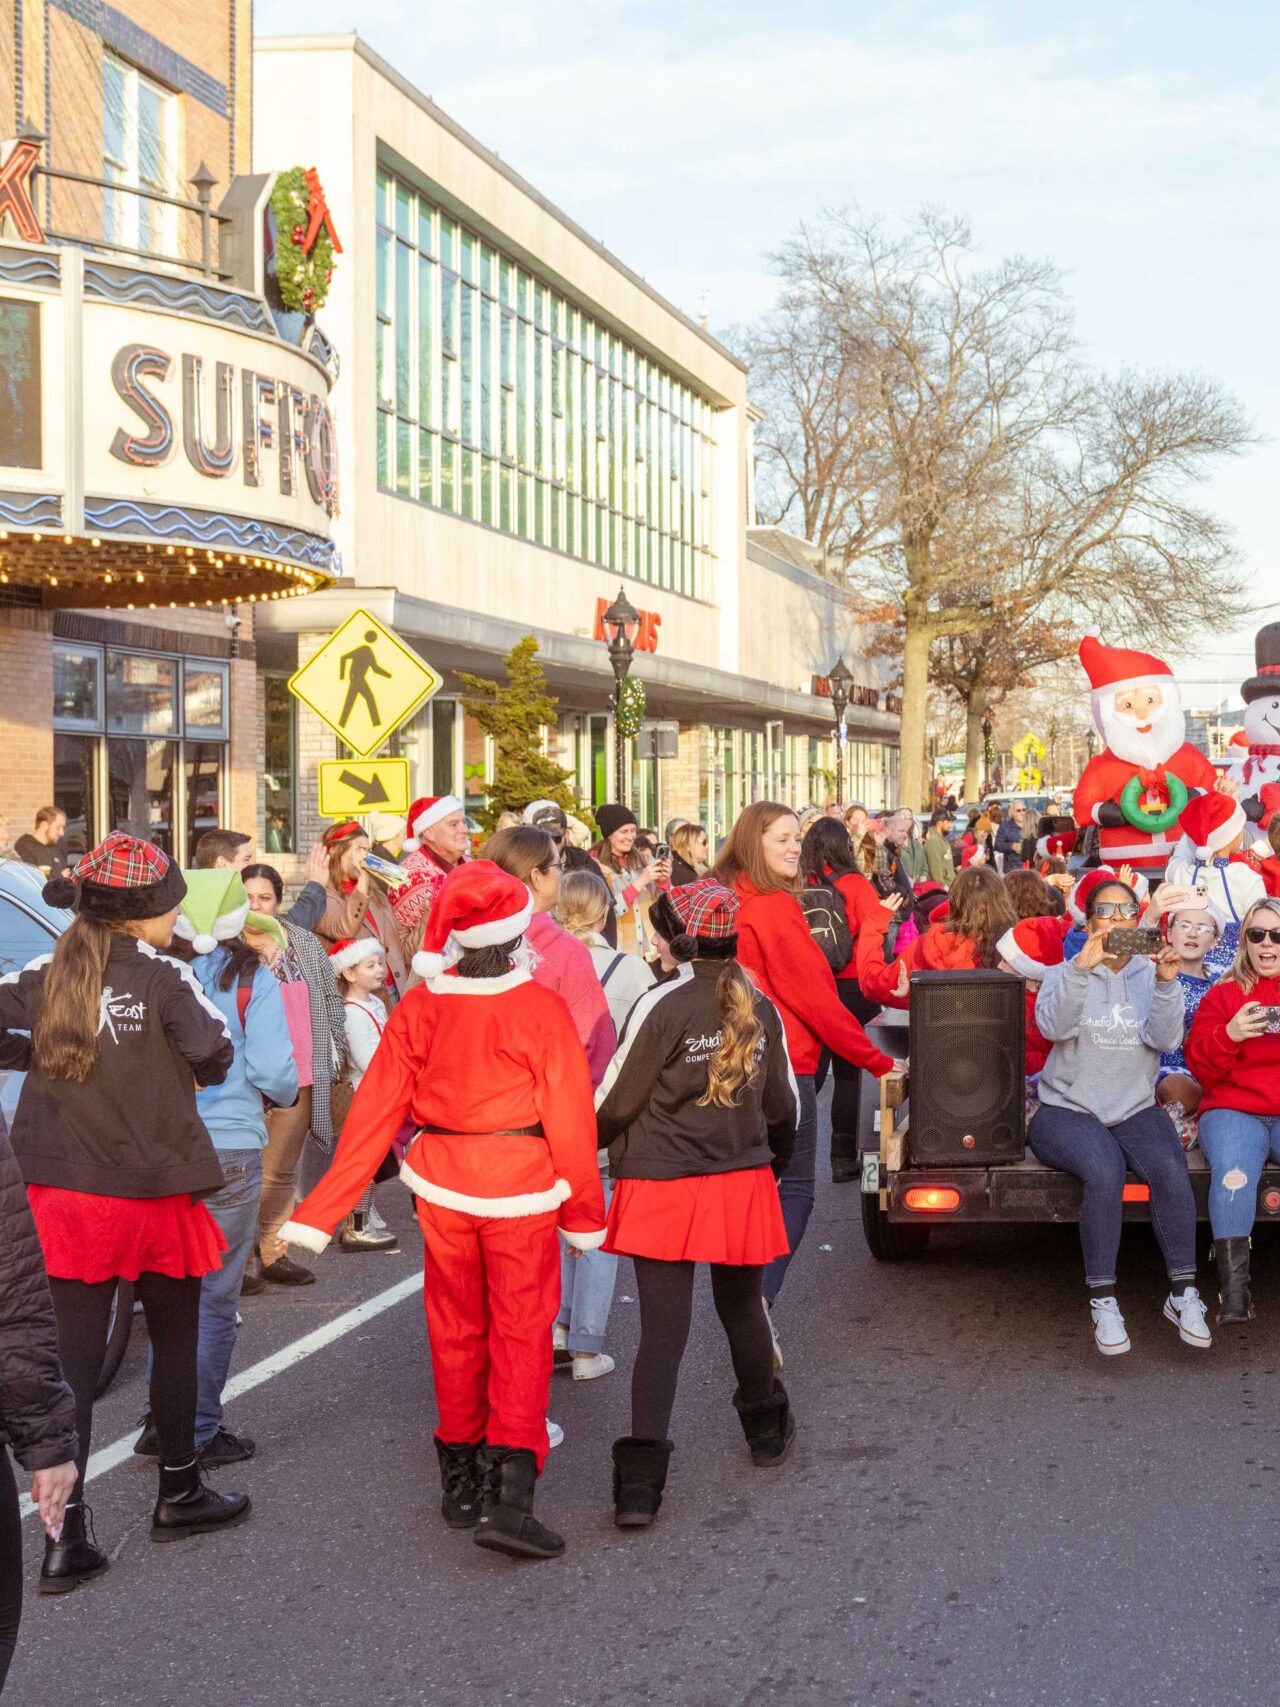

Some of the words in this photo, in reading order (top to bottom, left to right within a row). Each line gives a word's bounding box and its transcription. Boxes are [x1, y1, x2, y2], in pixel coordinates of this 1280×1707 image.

[109, 343, 340, 508] SUFFO
[108, 1002, 147, 1019] East
[1091, 1033, 1117, 1044] Dance
